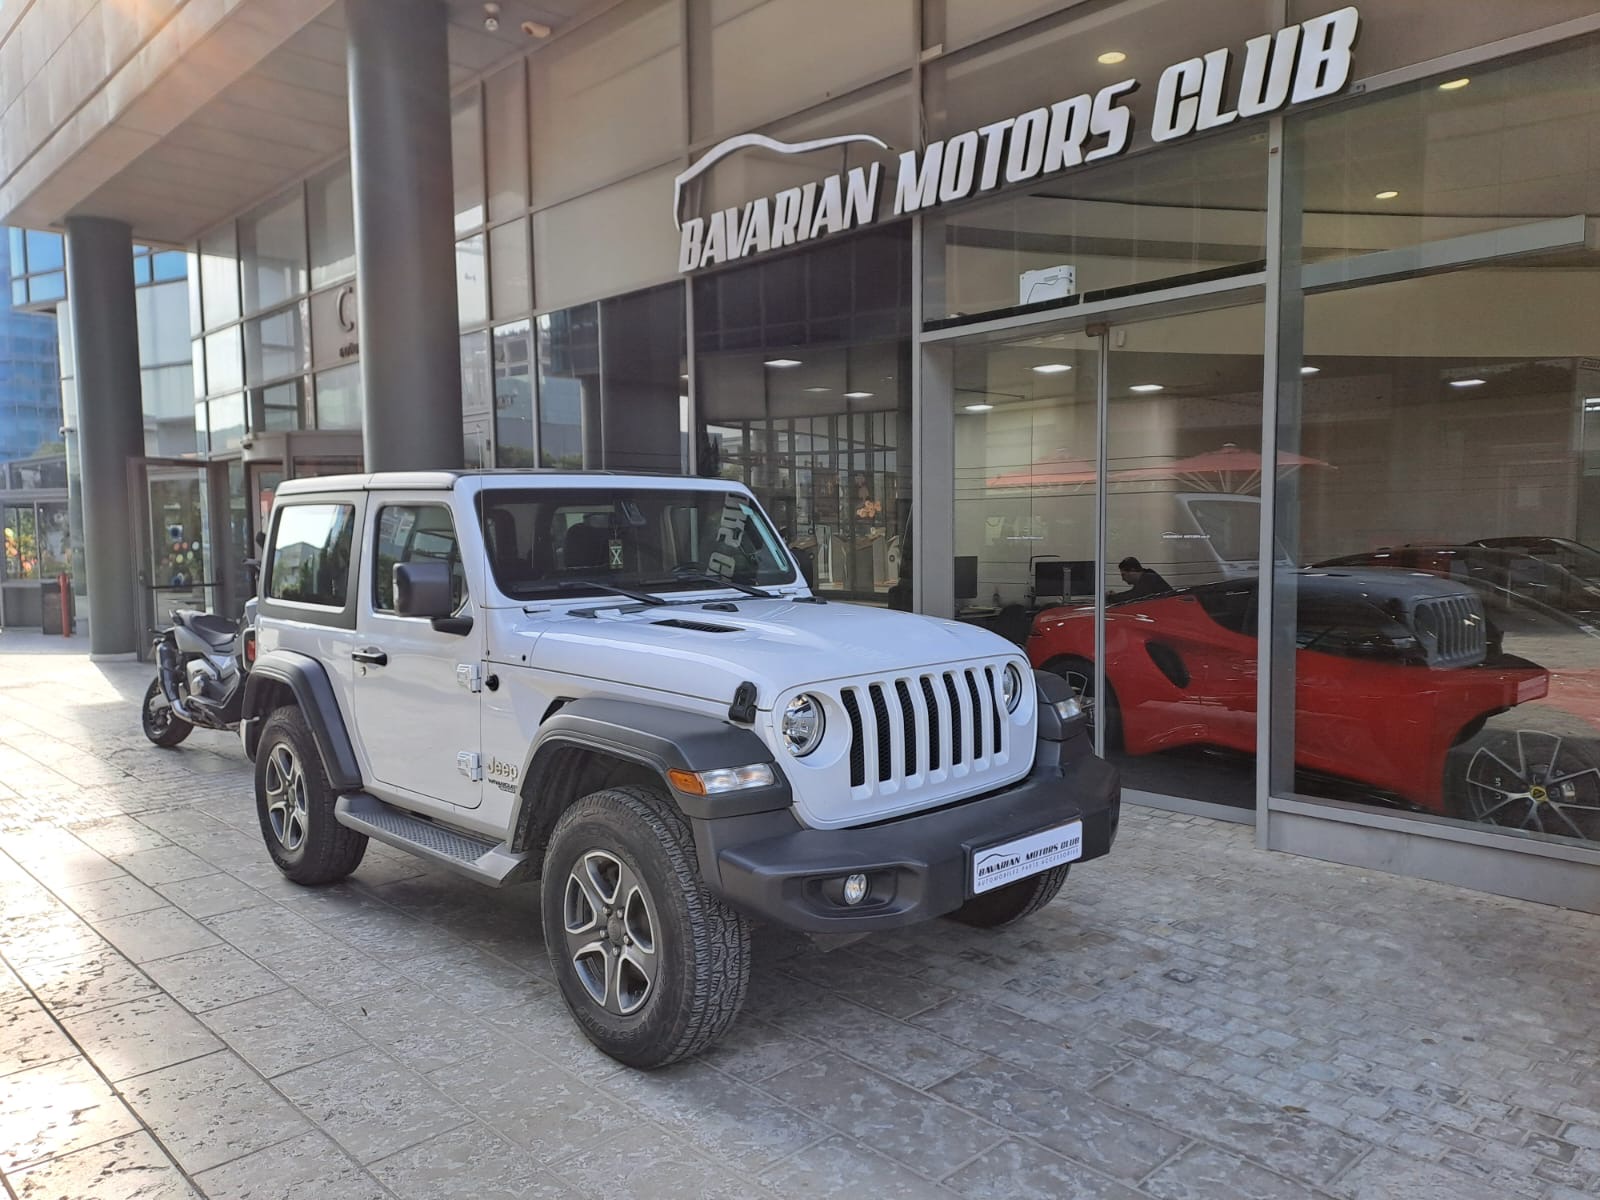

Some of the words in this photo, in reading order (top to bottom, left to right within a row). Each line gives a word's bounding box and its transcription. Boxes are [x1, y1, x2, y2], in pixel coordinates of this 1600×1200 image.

[678, 161, 880, 273] BAVARIAN
[893, 78, 1136, 216] MOTORS
[1151, 6, 1359, 142] CLUB
[488, 756, 518, 781] Jeep
[978, 856, 1021, 877] BAVARIAN
[1025, 843, 1058, 860] MOTORS
[1060, 837, 1080, 850] CLUB
